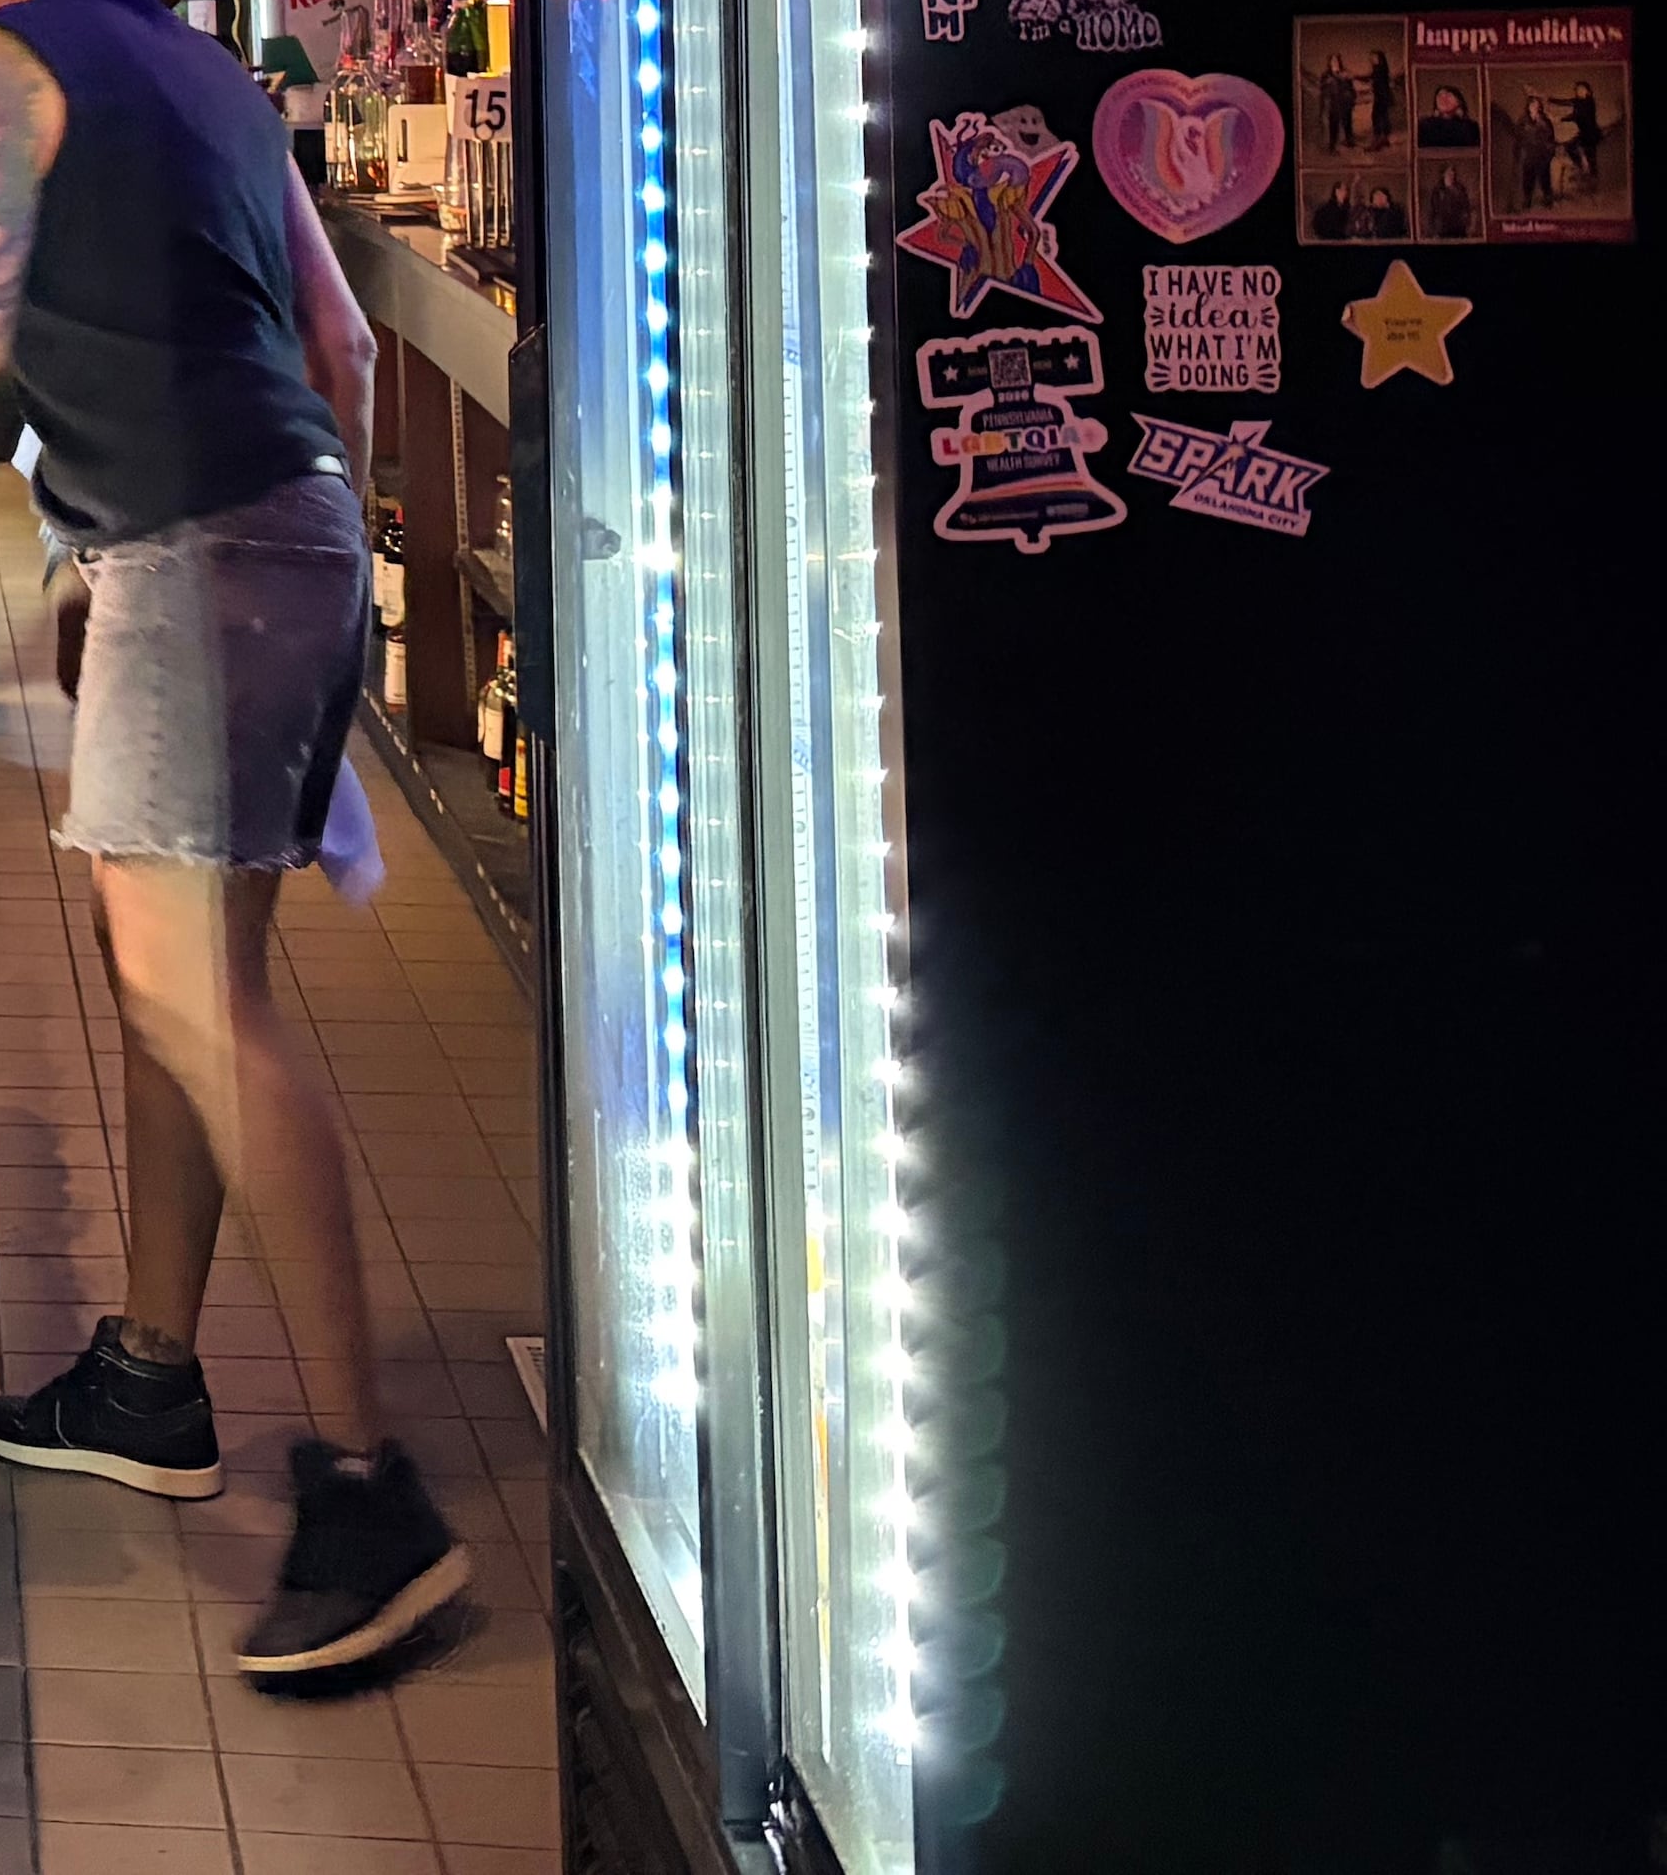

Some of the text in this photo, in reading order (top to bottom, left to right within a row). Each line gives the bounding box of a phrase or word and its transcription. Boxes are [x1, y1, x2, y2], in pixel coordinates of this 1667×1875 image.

[1416, 15, 1625, 54] happy holidays
[465, 88, 508, 131] 15
[1149, 270, 1277, 297] I HAVE NO
[1169, 291, 1259, 329] idea
[1150, 334, 1278, 361] WHAT I'M
[1179, 364, 1250, 387] DOING
[1139, 427, 1312, 512] SPARK
[1193, 493, 1299, 530] OKLAHOMA CITY
